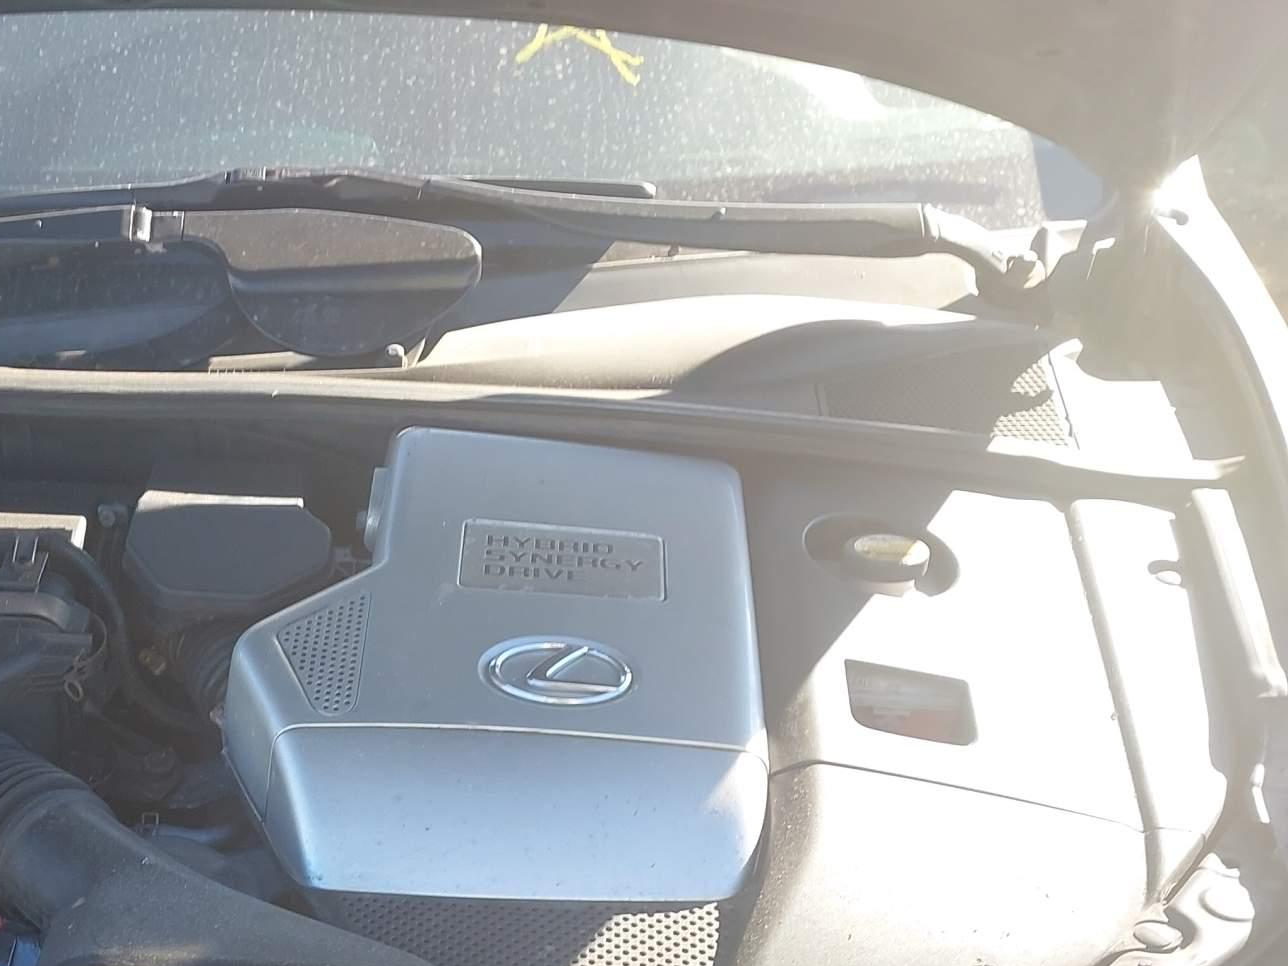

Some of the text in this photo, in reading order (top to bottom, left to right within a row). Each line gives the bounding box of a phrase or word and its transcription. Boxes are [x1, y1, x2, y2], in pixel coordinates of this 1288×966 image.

[486, 535, 614, 554] HYBRID
[483, 549, 644, 571] SYNERGY
[482, 563, 585, 582] DRIVE
